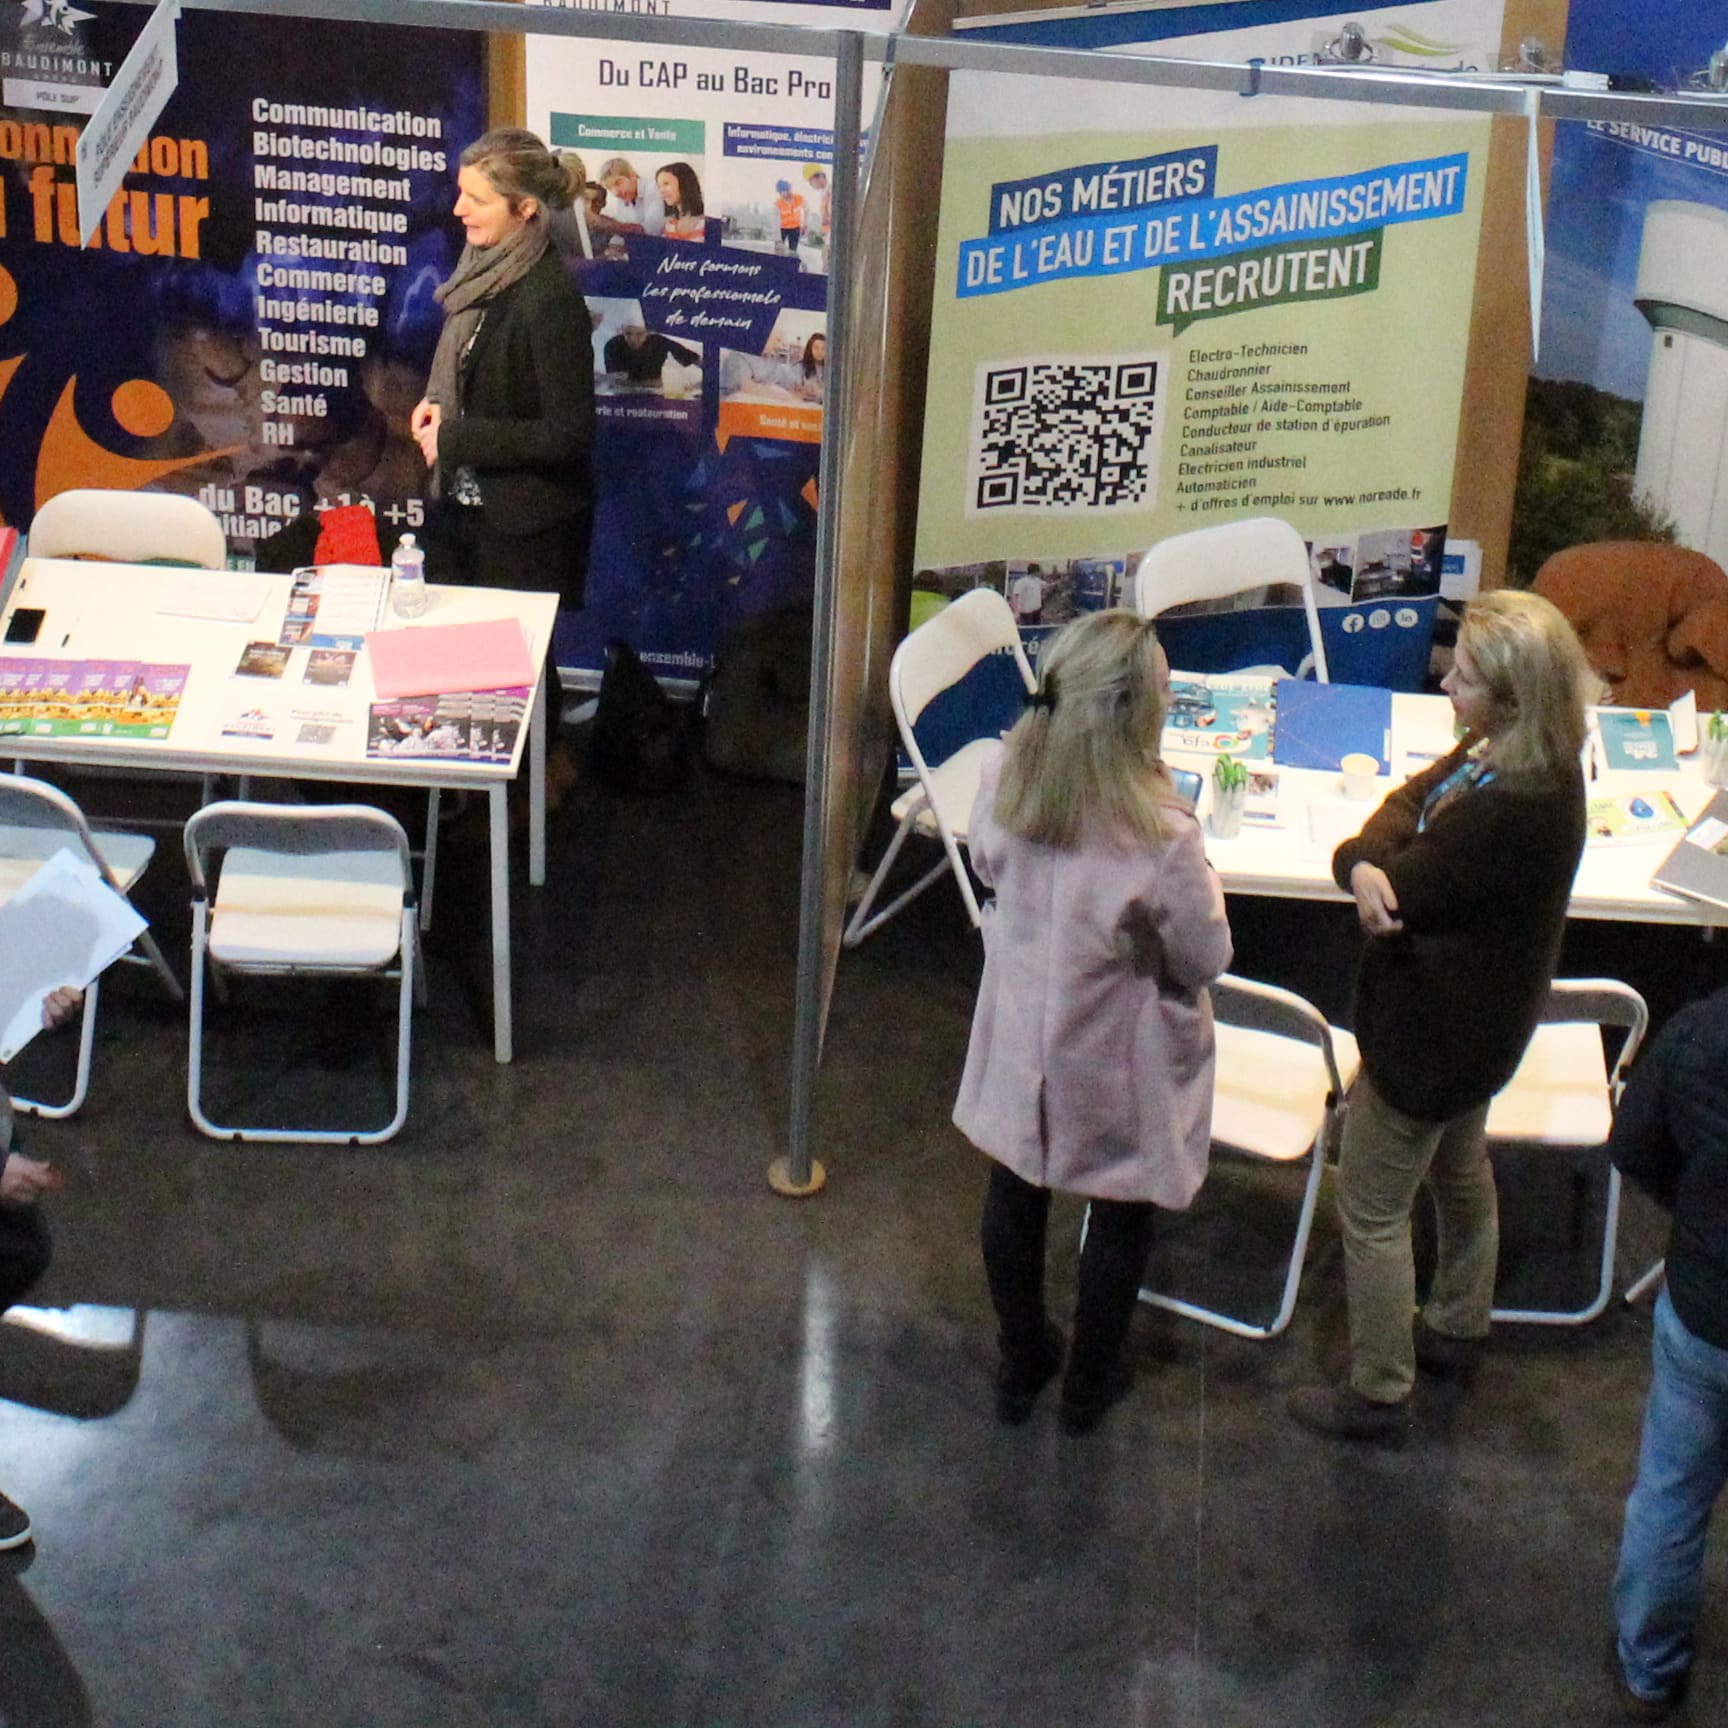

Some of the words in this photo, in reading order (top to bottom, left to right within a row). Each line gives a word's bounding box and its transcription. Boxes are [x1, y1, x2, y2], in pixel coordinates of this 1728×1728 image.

[0, 52, 113, 78] BAUDIMONT
[598, 59, 631, 87] Du
[638, 60, 688, 90] CAP
[695, 69, 725, 92] au
[733, 67, 779, 95] Bac
[787, 70, 832, 100] Pro
[251, 97, 442, 140] Communication
[569, 123, 633, 142] Commerce
[646, 127, 678, 143] Vente
[252, 130, 447, 174] Biotechnologies
[1608, 119, 1681, 156] SERVICE
[253, 164, 412, 203] Management
[999, 180, 1062, 229] NOS
[1071, 155, 1208, 215] MÉTIERS
[28, 164, 211, 260] futur
[254, 198, 409, 235] Informatique
[967, 246, 1005, 289] DE
[1010, 230, 1092, 282] L'EAU
[1102, 223, 1136, 267] ET
[1144, 214, 1181, 256] DE
[1189, 165, 1462, 252] L'ASSAINISSEMENT
[255, 231, 408, 267] Restauration
[256, 262, 387, 298] Commerce
[1166, 240, 1376, 316] RECRUTENT
[669, 283, 782, 306] professionnels
[257, 296, 380, 329] Ingénierie
[664, 309, 687, 328] de
[690, 312, 753, 331] demain
[258, 327, 367, 360] Tourisme
[259, 360, 349, 389] Gestion
[1187, 363, 1273, 383] Chaudronnier
[260, 390, 329, 418] Santé
[1185, 384, 1248, 402] Conseiller
[1250, 380, 1352, 396] Assainissement
[1183, 402, 1250, 422] Comptable
[1260, 398, 1363, 415] Aide-Comptable
[261, 421, 294, 447] RH
[1181, 421, 1253, 440] Conducteur
[1256, 419, 1273, 433] de
[1275, 418, 1319, 433] station
[1180, 440, 1258, 458] Canalisateur
[1246, 455, 1308, 472] industriel
[1175, 476, 1257, 495] Automaticien
[1298, 494, 1320, 507] sur
[198, 482, 237, 513] du
[244, 485, 301, 517] Bac
[383, 498, 425, 528] +5
